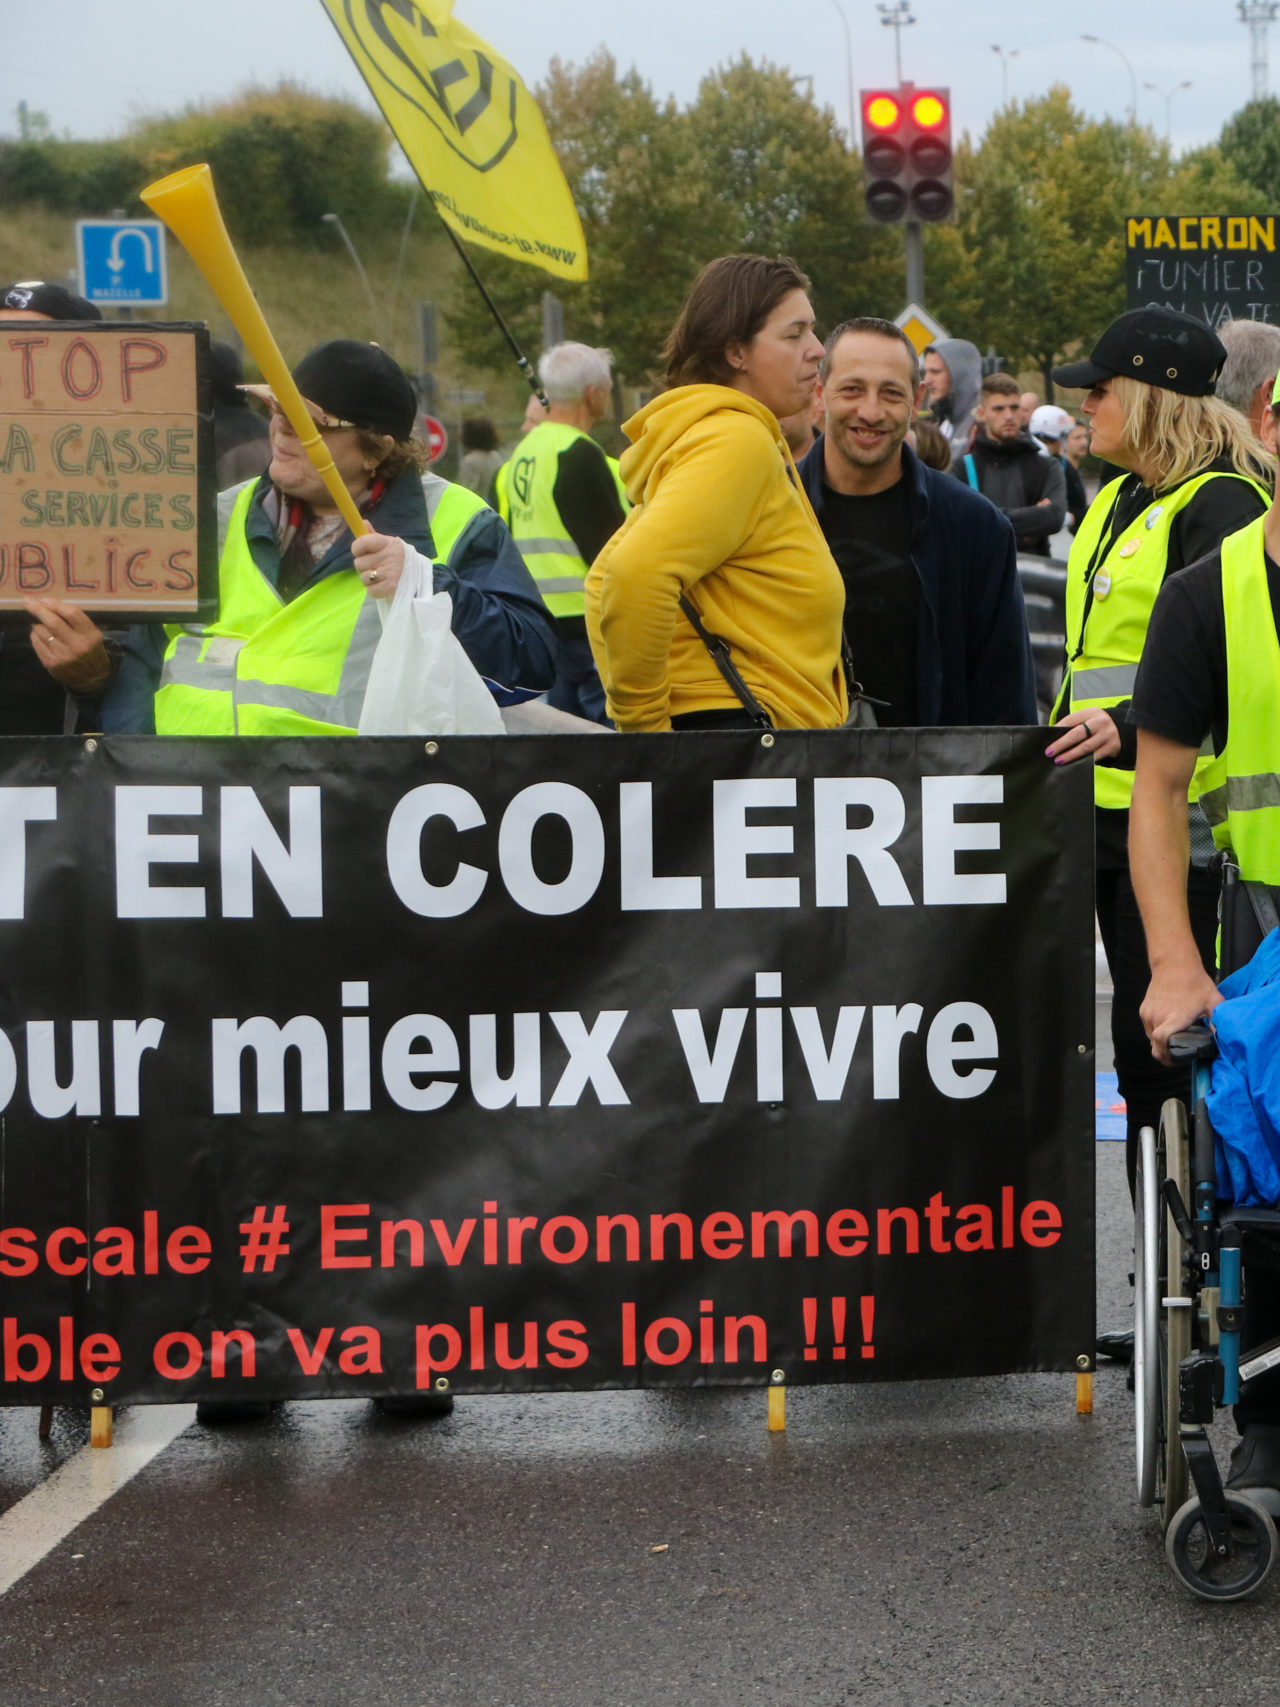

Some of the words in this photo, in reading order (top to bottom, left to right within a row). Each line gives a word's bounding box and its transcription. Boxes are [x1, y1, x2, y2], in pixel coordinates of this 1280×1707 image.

[1127, 216, 1276, 252] MACRON
[0, 424, 35, 474] A
[53, 423, 196, 477] CASSE
[20, 479, 196, 531] SERVICES
[115, 785, 323, 919] EN
[386, 774, 1007, 918] COLERE
[212, 981, 632, 1114] mieux
[671, 971, 999, 1104] vivre
[239, 1204, 291, 1273] #
[320, 1185, 1063, 1271] Environnementale
[3, 1316, 122, 1383] ble
[152, 1328, 257, 1381] on
[285, 1325, 384, 1376] va
[415, 1305, 590, 1390] plus
[621, 1300, 769, 1367] loin
[802, 1294, 877, 1362] !!!
